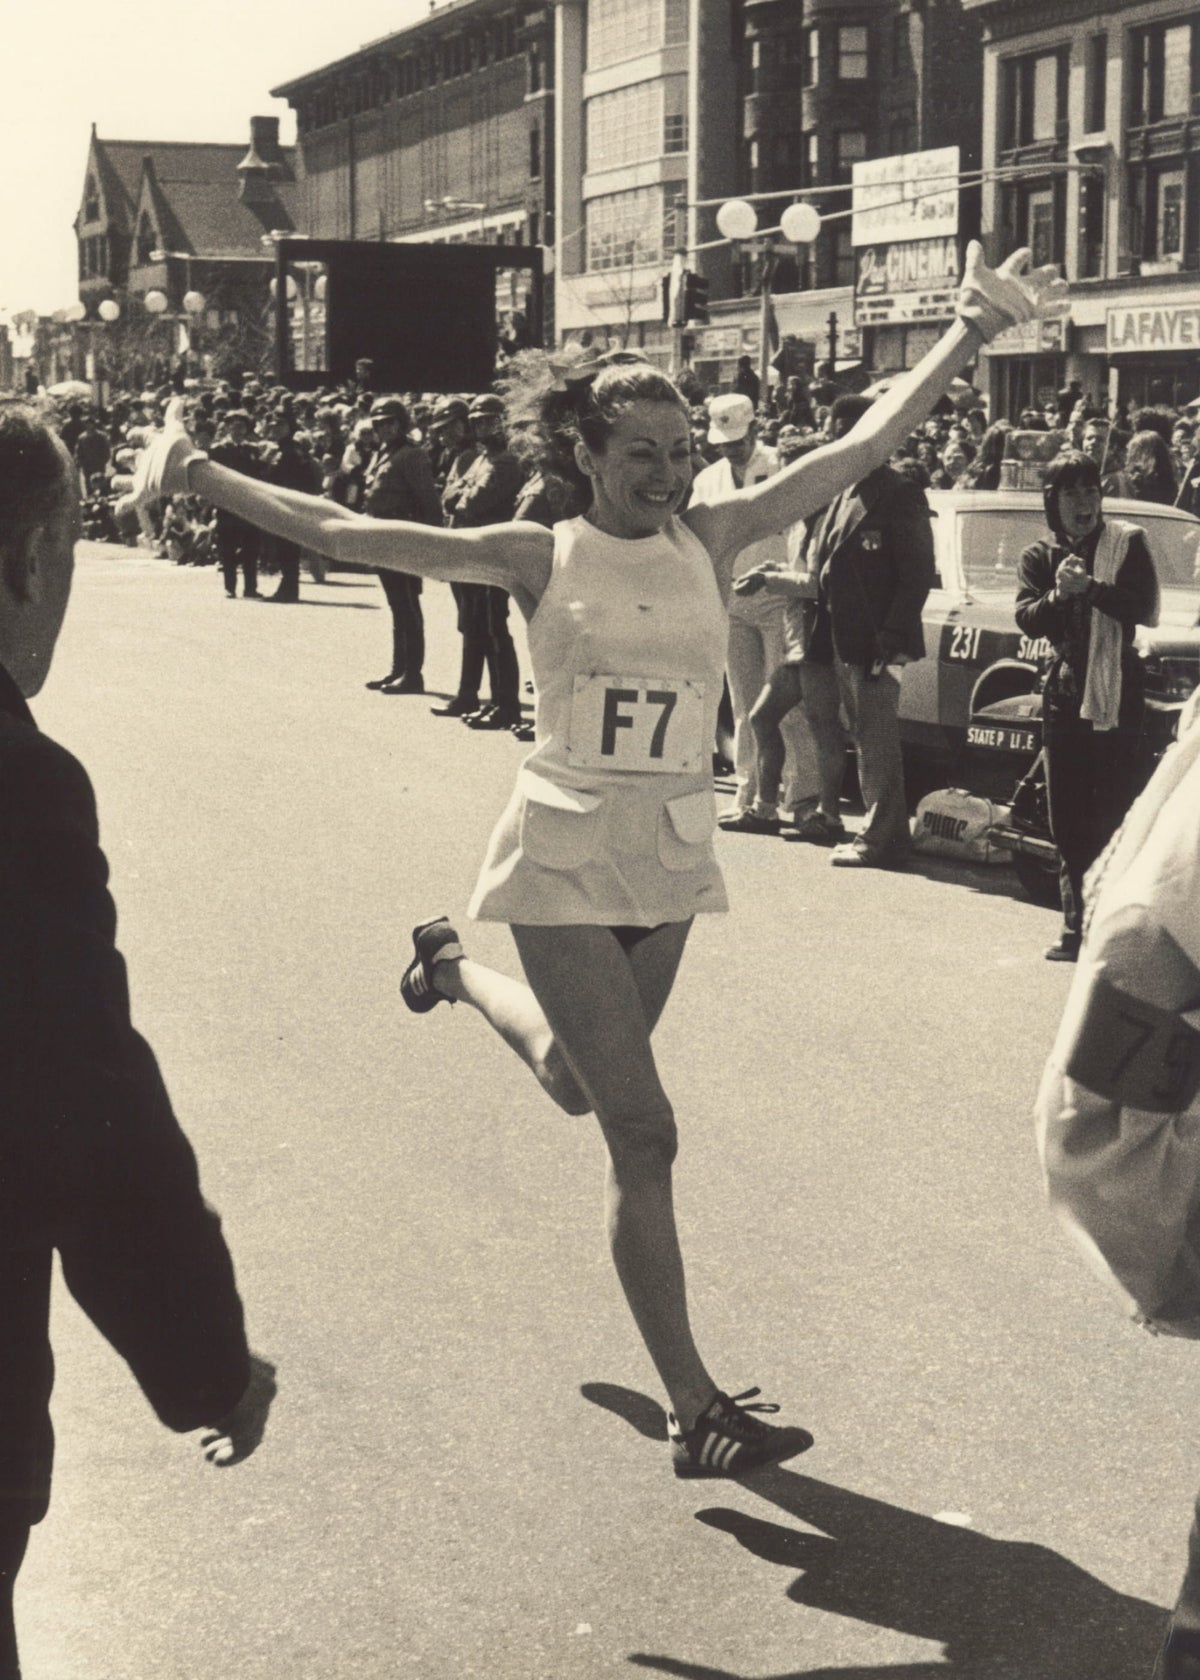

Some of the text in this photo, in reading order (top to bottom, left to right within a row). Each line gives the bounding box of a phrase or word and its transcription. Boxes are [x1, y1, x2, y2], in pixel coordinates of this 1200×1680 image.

[886, 237, 959, 281] CINEMA
[950, 626, 981, 659] 231
[600, 688, 678, 758] F7
[967, 727, 1034, 750] STATE PLIE
